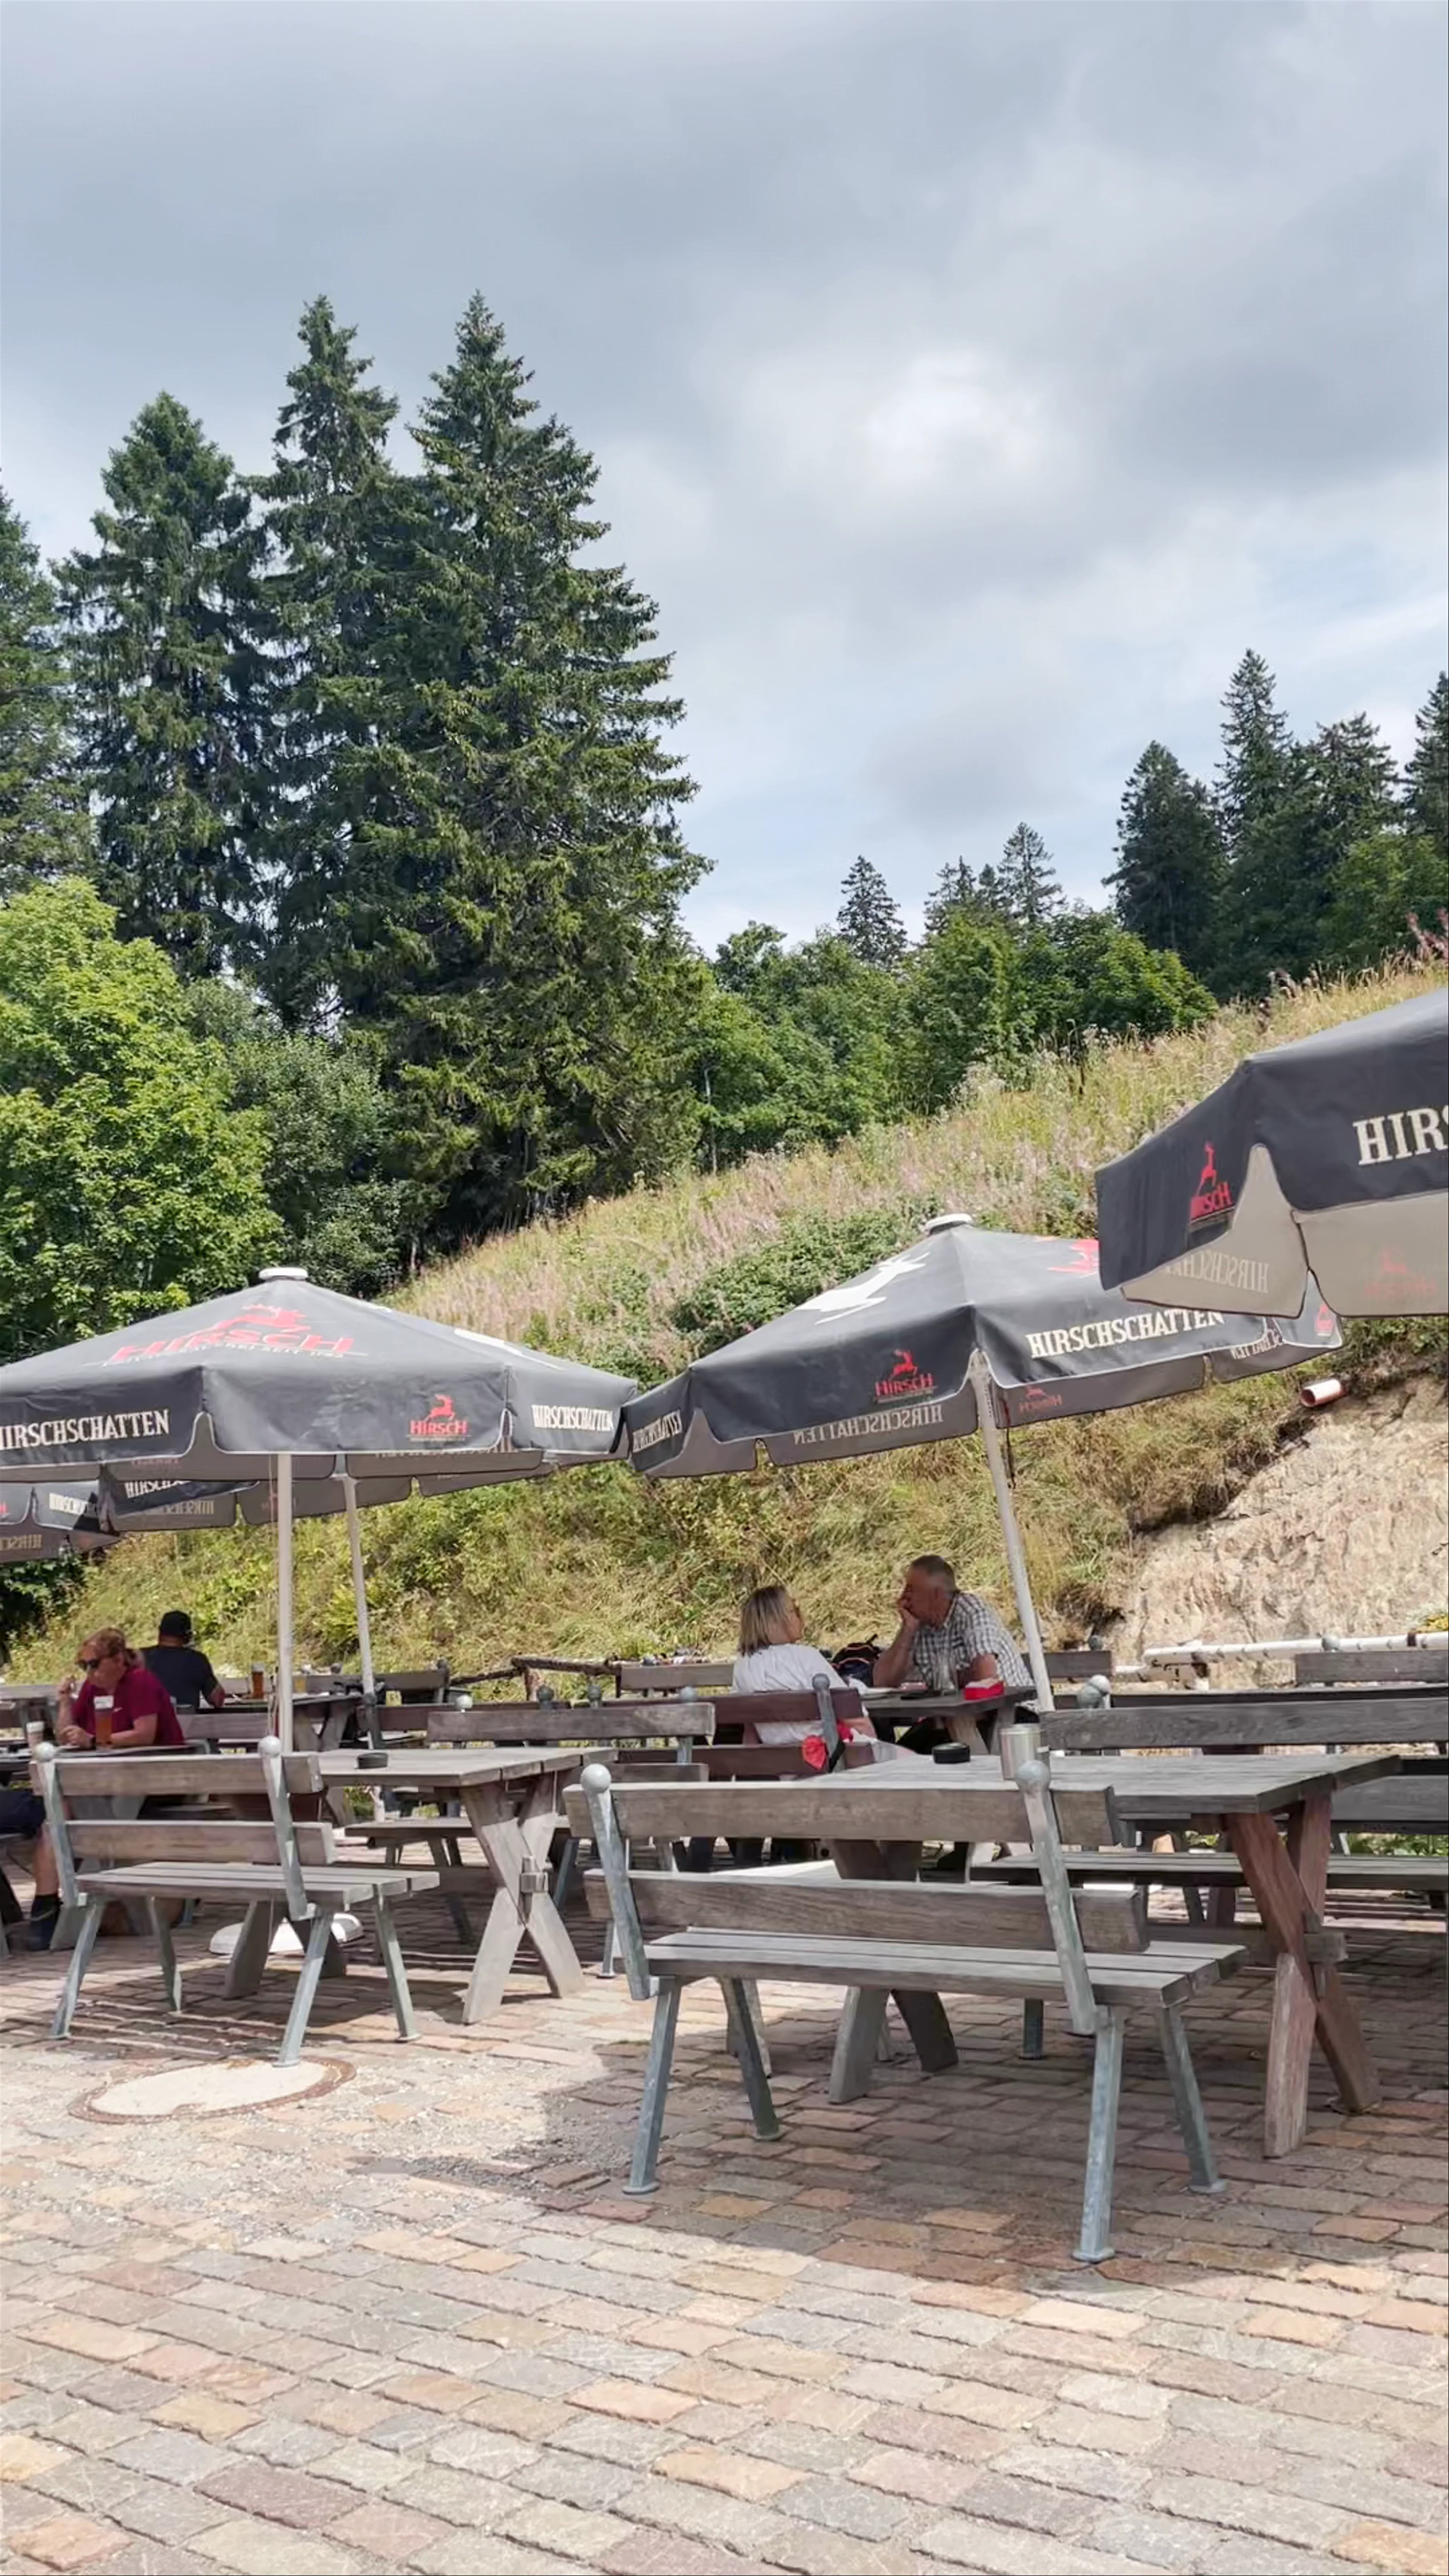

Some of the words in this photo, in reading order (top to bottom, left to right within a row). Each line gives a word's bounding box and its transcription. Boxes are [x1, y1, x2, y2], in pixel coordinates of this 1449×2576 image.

[112, 1329, 354, 1363] HIRSCH
[1025, 1309, 1225, 1359] HIRSCHSCHATTEN
[875, 1373, 934, 1396] HIRSCH
[410, 1420, 468, 1435] HIRSCH
